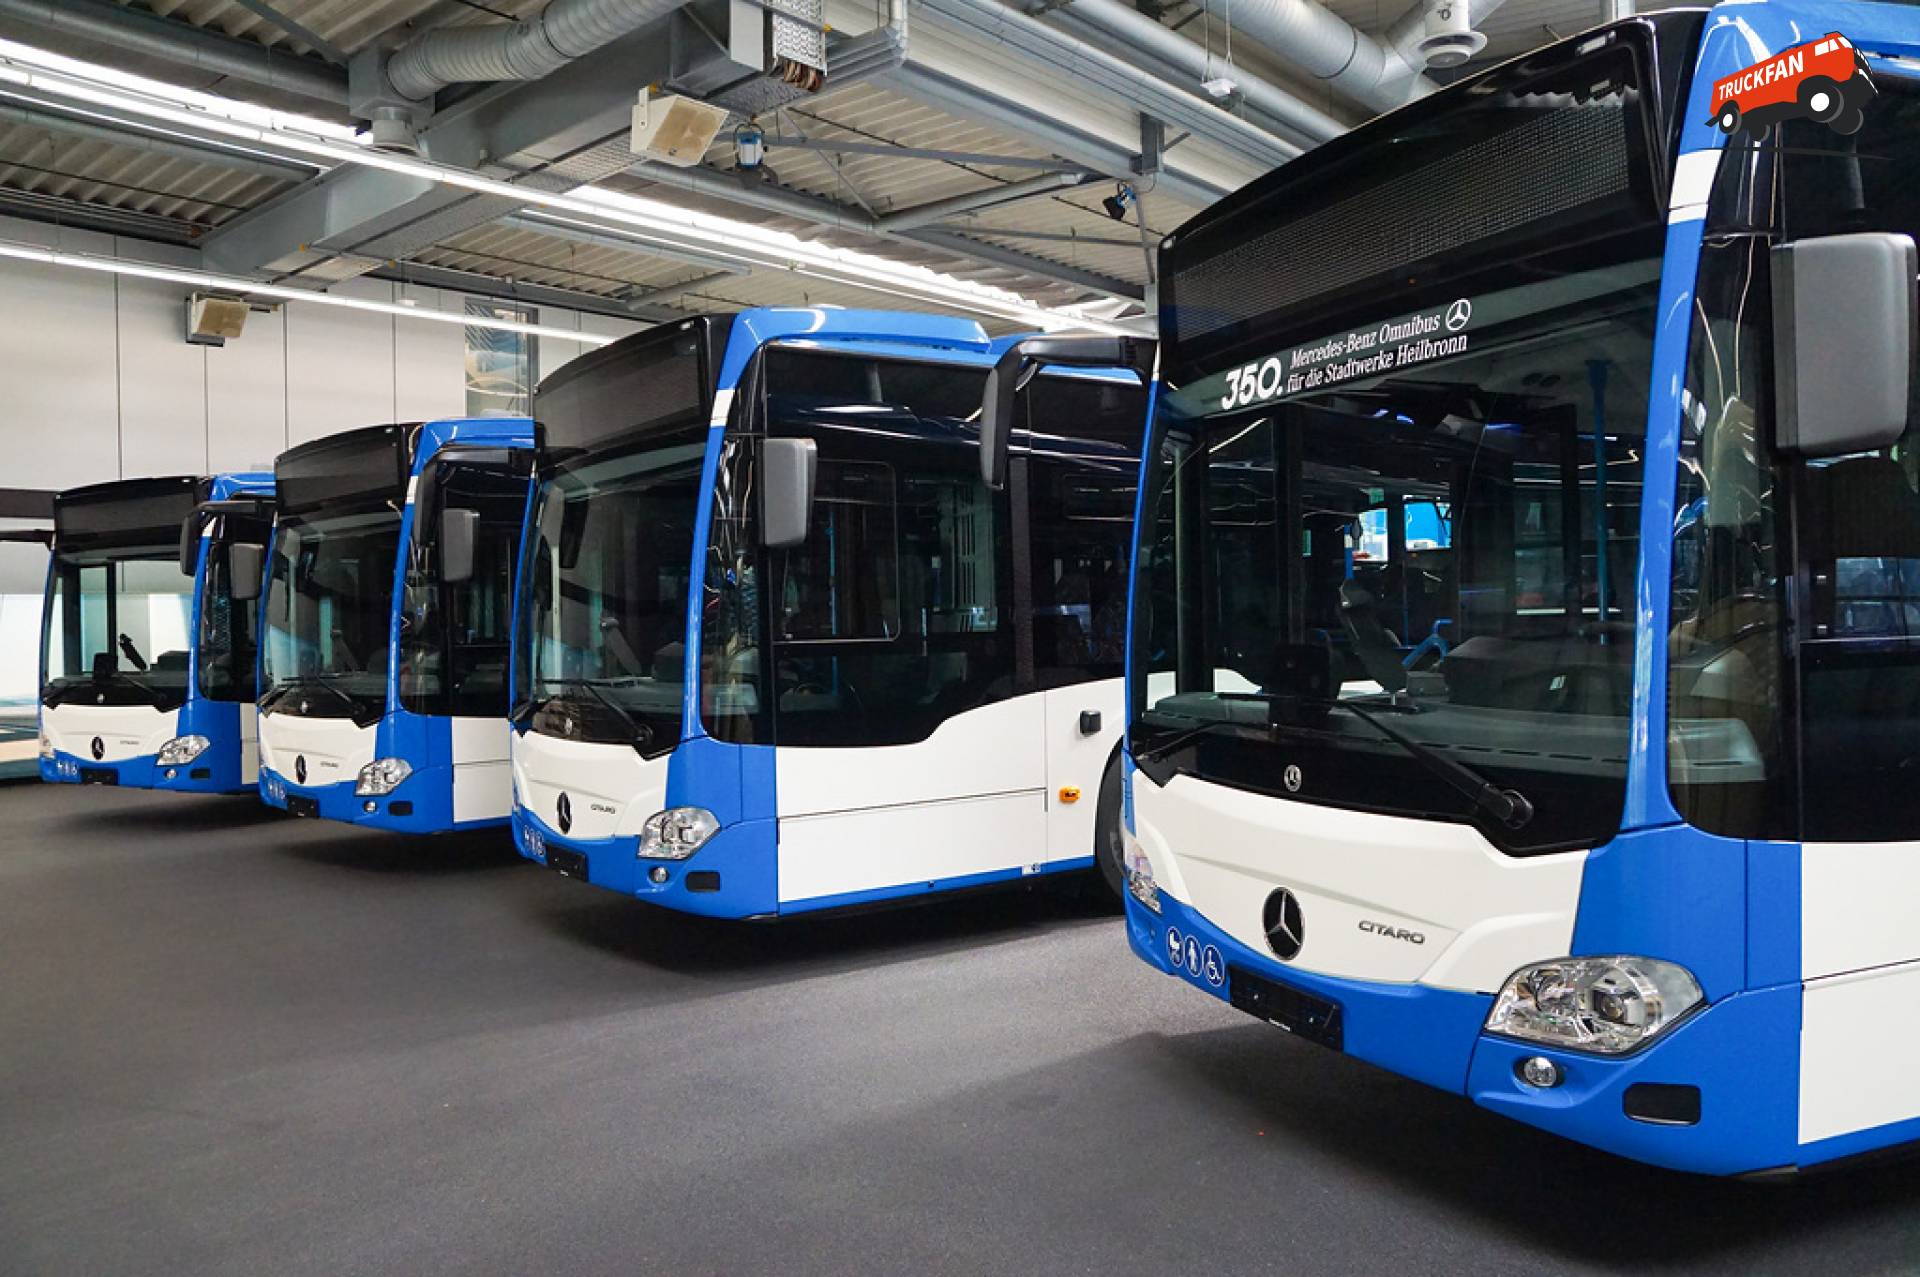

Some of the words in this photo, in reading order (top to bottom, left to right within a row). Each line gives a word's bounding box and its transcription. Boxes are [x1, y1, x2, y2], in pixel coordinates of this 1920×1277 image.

[1287, 373, 1305, 393] für
[1305, 368, 1323, 388] die
[1325, 350, 1394, 383] Stadtwerke
[1396, 335, 1467, 366] Heilbronn
[1290, 331, 1377, 370] Mercedes-Benz
[1380, 315, 1440, 343] Omnibus
[1221, 357, 1283, 410] 350.
[1358, 920, 1425, 945] CITARO
